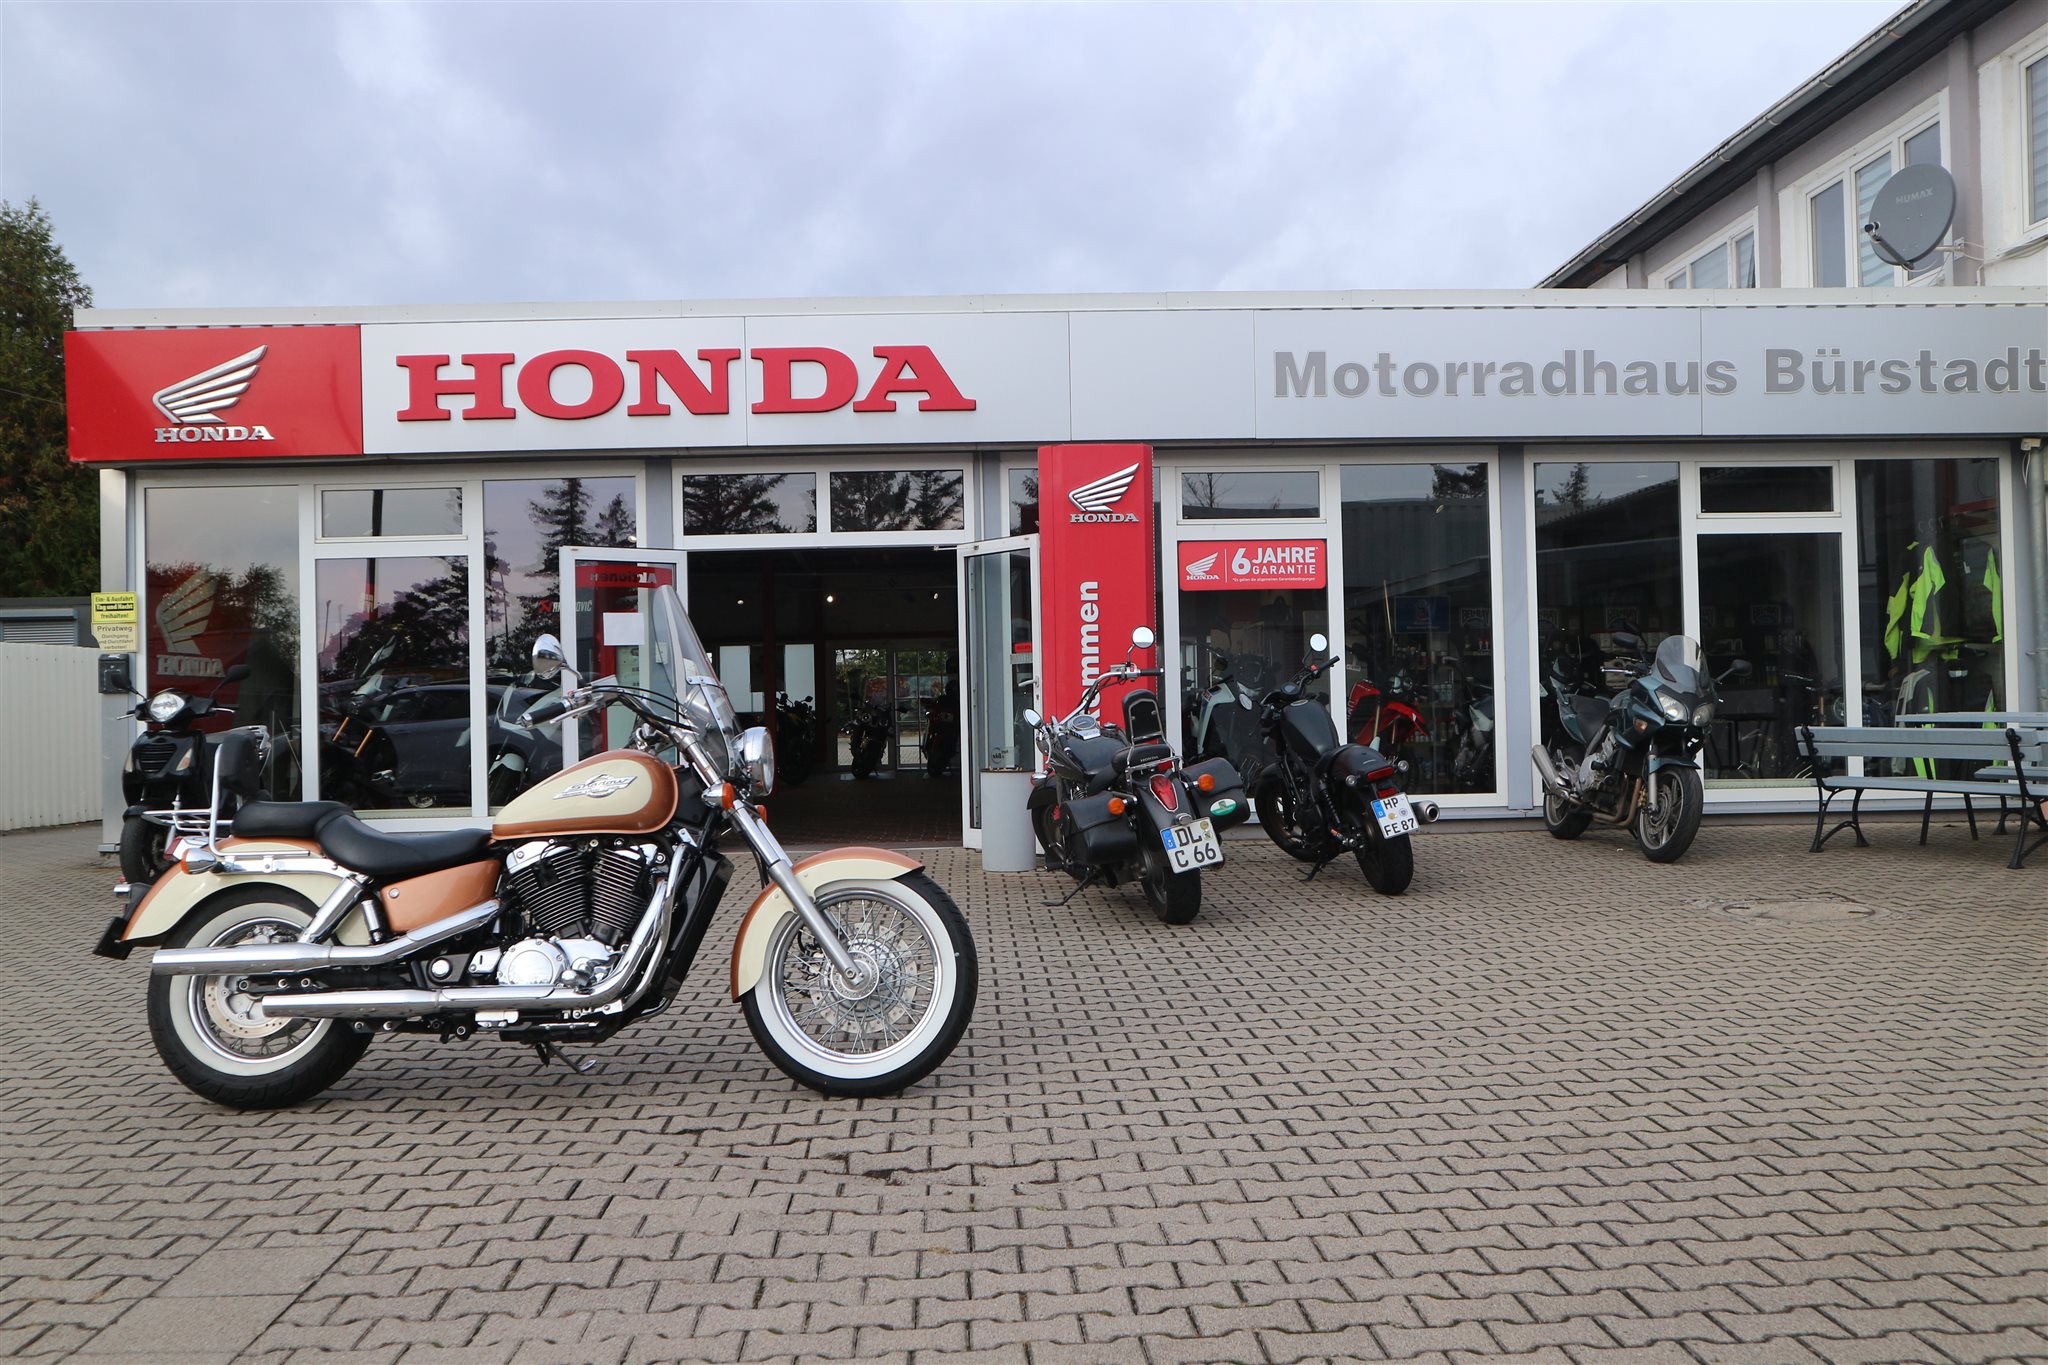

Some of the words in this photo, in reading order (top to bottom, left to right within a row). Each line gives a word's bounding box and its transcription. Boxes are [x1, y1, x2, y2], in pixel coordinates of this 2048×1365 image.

[1894, 187, 1934, 206] HUMAX
[1273, 348, 1737, 399] Motorradhaus
[1764, 346, 2048, 395] Bürstadt
[395, 345, 977, 422] HONDA
[154, 424, 275, 444] HONDA
[1070, 513, 1139, 524] HONDA
[1231, 547, 1251, 576] 6
[1252, 564, 1316, 575] GARANTIE
[156, 654, 226, 678] HONDA
[1383, 797, 1399, 810] HP
[1174, 826, 1203, 847] DL
[1384, 822, 1401, 836] FE
[1401, 818, 1415, 831] 87
[1174, 849, 1189, 868] C
[1193, 842, 1217, 863] 66
